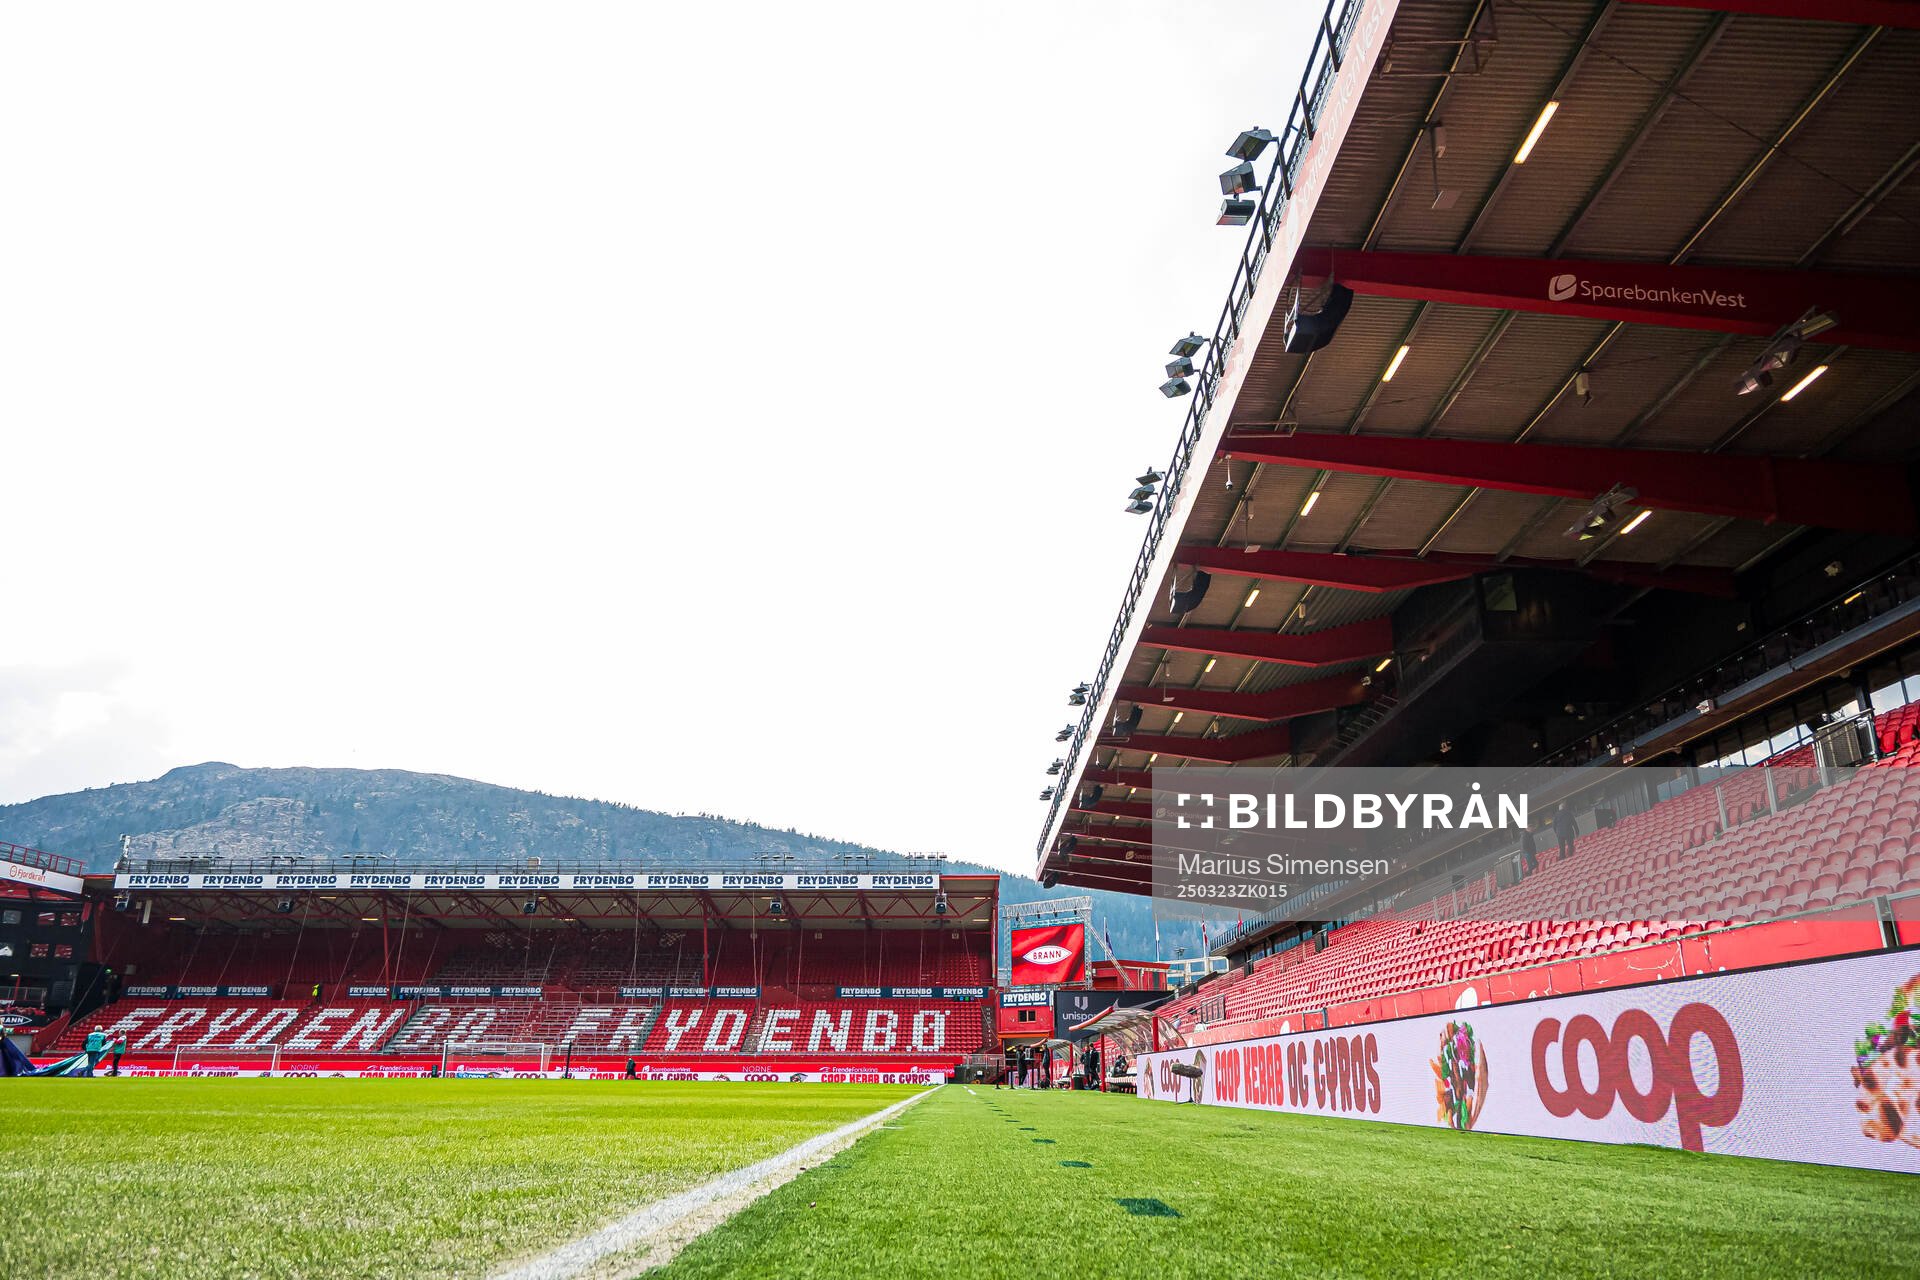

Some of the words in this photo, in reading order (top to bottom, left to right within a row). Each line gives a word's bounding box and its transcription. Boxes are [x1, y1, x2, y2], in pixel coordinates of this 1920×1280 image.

[1580, 280, 1747, 308] SparebankenVest
[17, 869, 46, 882] Fjordkraft
[129, 875, 189, 884] FRYDENBØ
[203, 875, 263, 884] FRYDENBØ
[276, 875, 337, 884] FRYDENBØ
[350, 876, 411, 885] FRYDENBØ
[424, 876, 485, 885] FRYDENBØ
[498, 876, 560, 885] FRYDENBØ
[573, 876, 634, 885] FRYDENBØ
[648, 876, 709, 885] FRYDENBØ
[722, 876, 784, 885] FRYDENBØ
[797, 876, 858, 885] FRYDENBØ
[872, 876, 933, 885] FRYDENBØ
[1033, 949, 1062, 960] BRANN
[1004, 992, 1046, 1002] FRYDENBØ
[1062, 1011, 1096, 1022] unispo
[1215, 1048, 1240, 1102] COOP
[1245, 1042, 1284, 1106] KEBAB
[1287, 1041, 1309, 1108] OG
[1313, 1033, 1381, 1114] GYROS
[1531, 1002, 1743, 1152] coop
[821, 1074, 846, 1083] COOP
[849, 1074, 879, 1083] KEBAB
[882, 1075, 896, 1083] OG
[899, 1074, 930, 1084] GYROS
